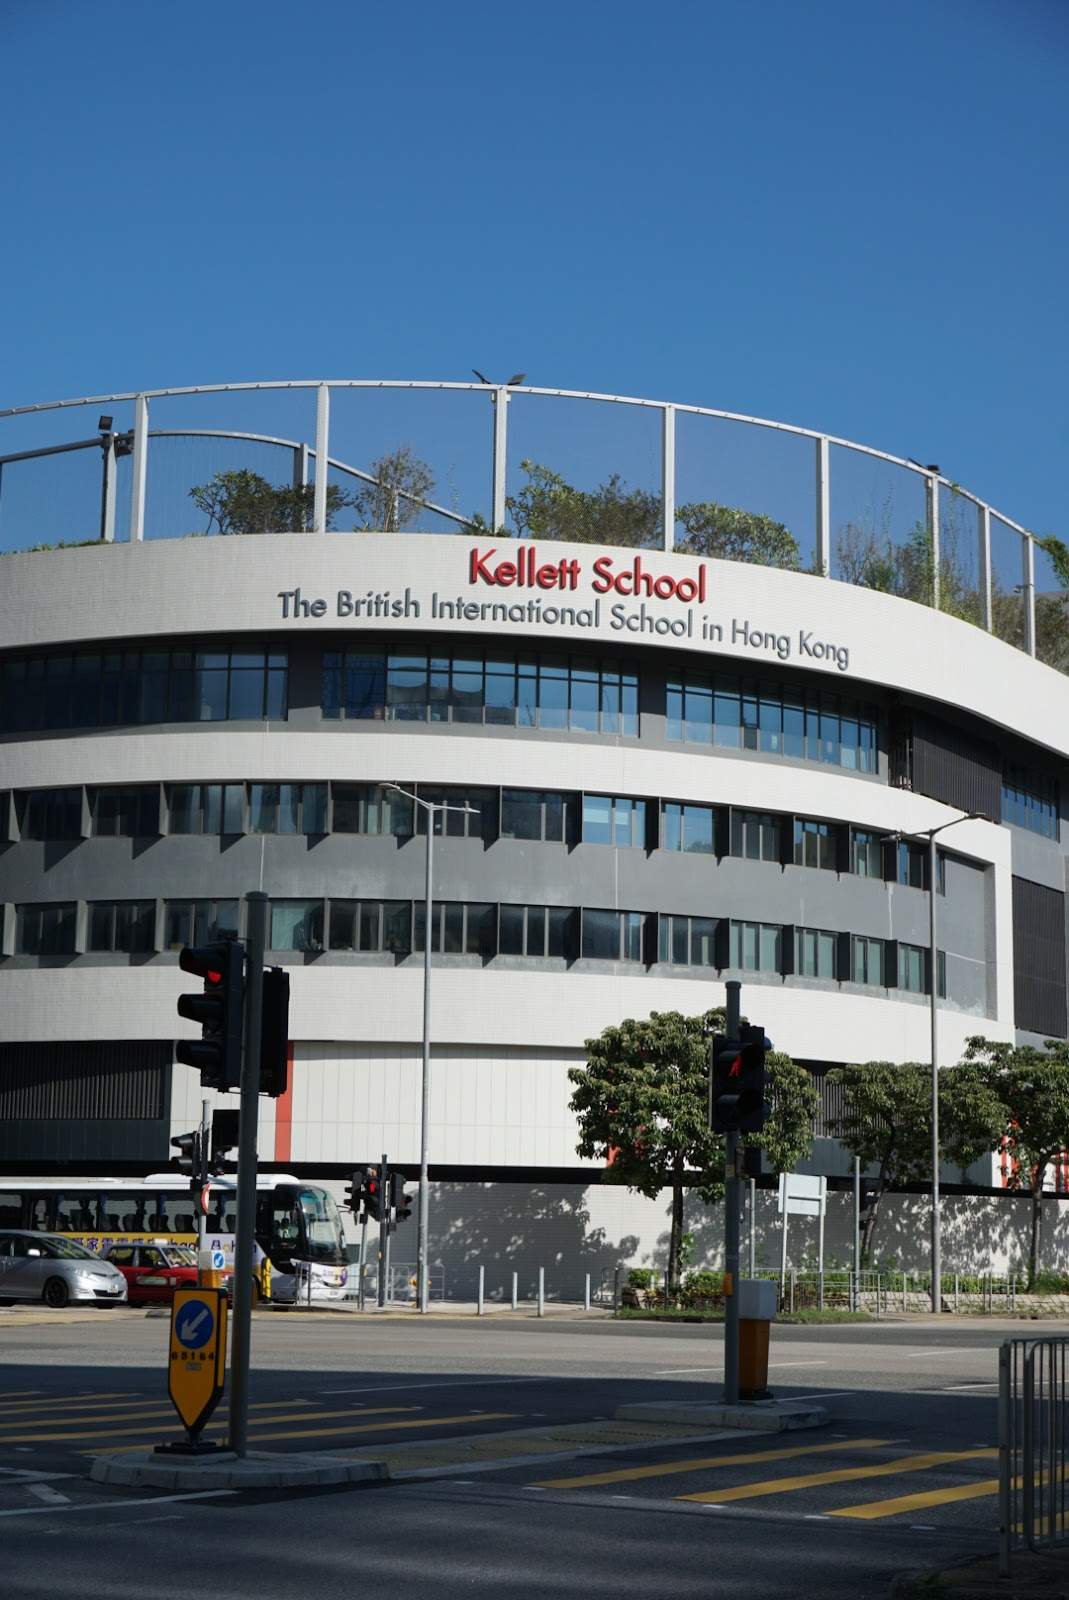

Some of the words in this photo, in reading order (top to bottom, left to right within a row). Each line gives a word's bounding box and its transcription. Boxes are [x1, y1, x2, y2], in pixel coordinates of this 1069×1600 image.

[469, 545, 581, 591] Kellett
[591, 555, 706, 604] School
[277, 587, 328, 619] The
[336, 587, 420, 618] British
[431, 592, 601, 628] International
[610, 603, 693, 638] School
[702, 615, 723, 642] in
[731, 618, 791, 660] Hong
[799, 630, 849, 671] Kong
